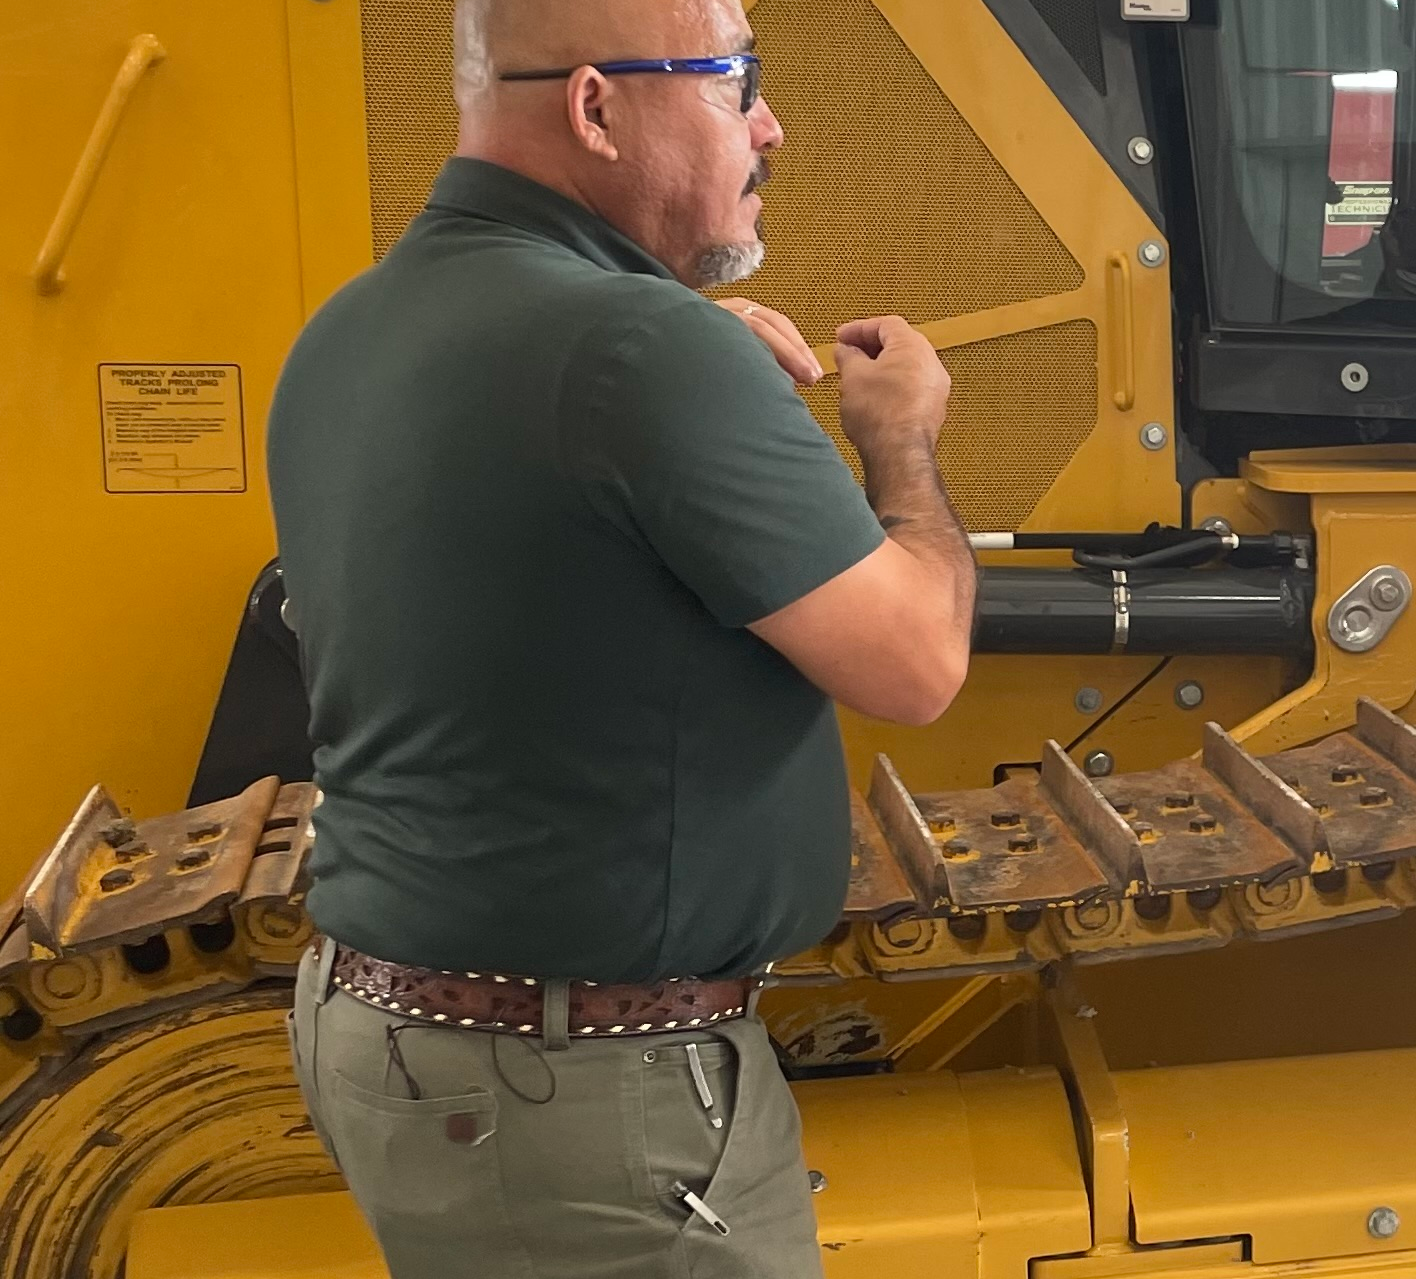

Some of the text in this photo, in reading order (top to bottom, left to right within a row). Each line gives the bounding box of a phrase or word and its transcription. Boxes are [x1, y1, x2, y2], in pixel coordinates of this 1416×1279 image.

[111, 370, 226, 378] PROPERLY ADJUSTED
[120, 379, 219, 387] TRACKS PROLONG
